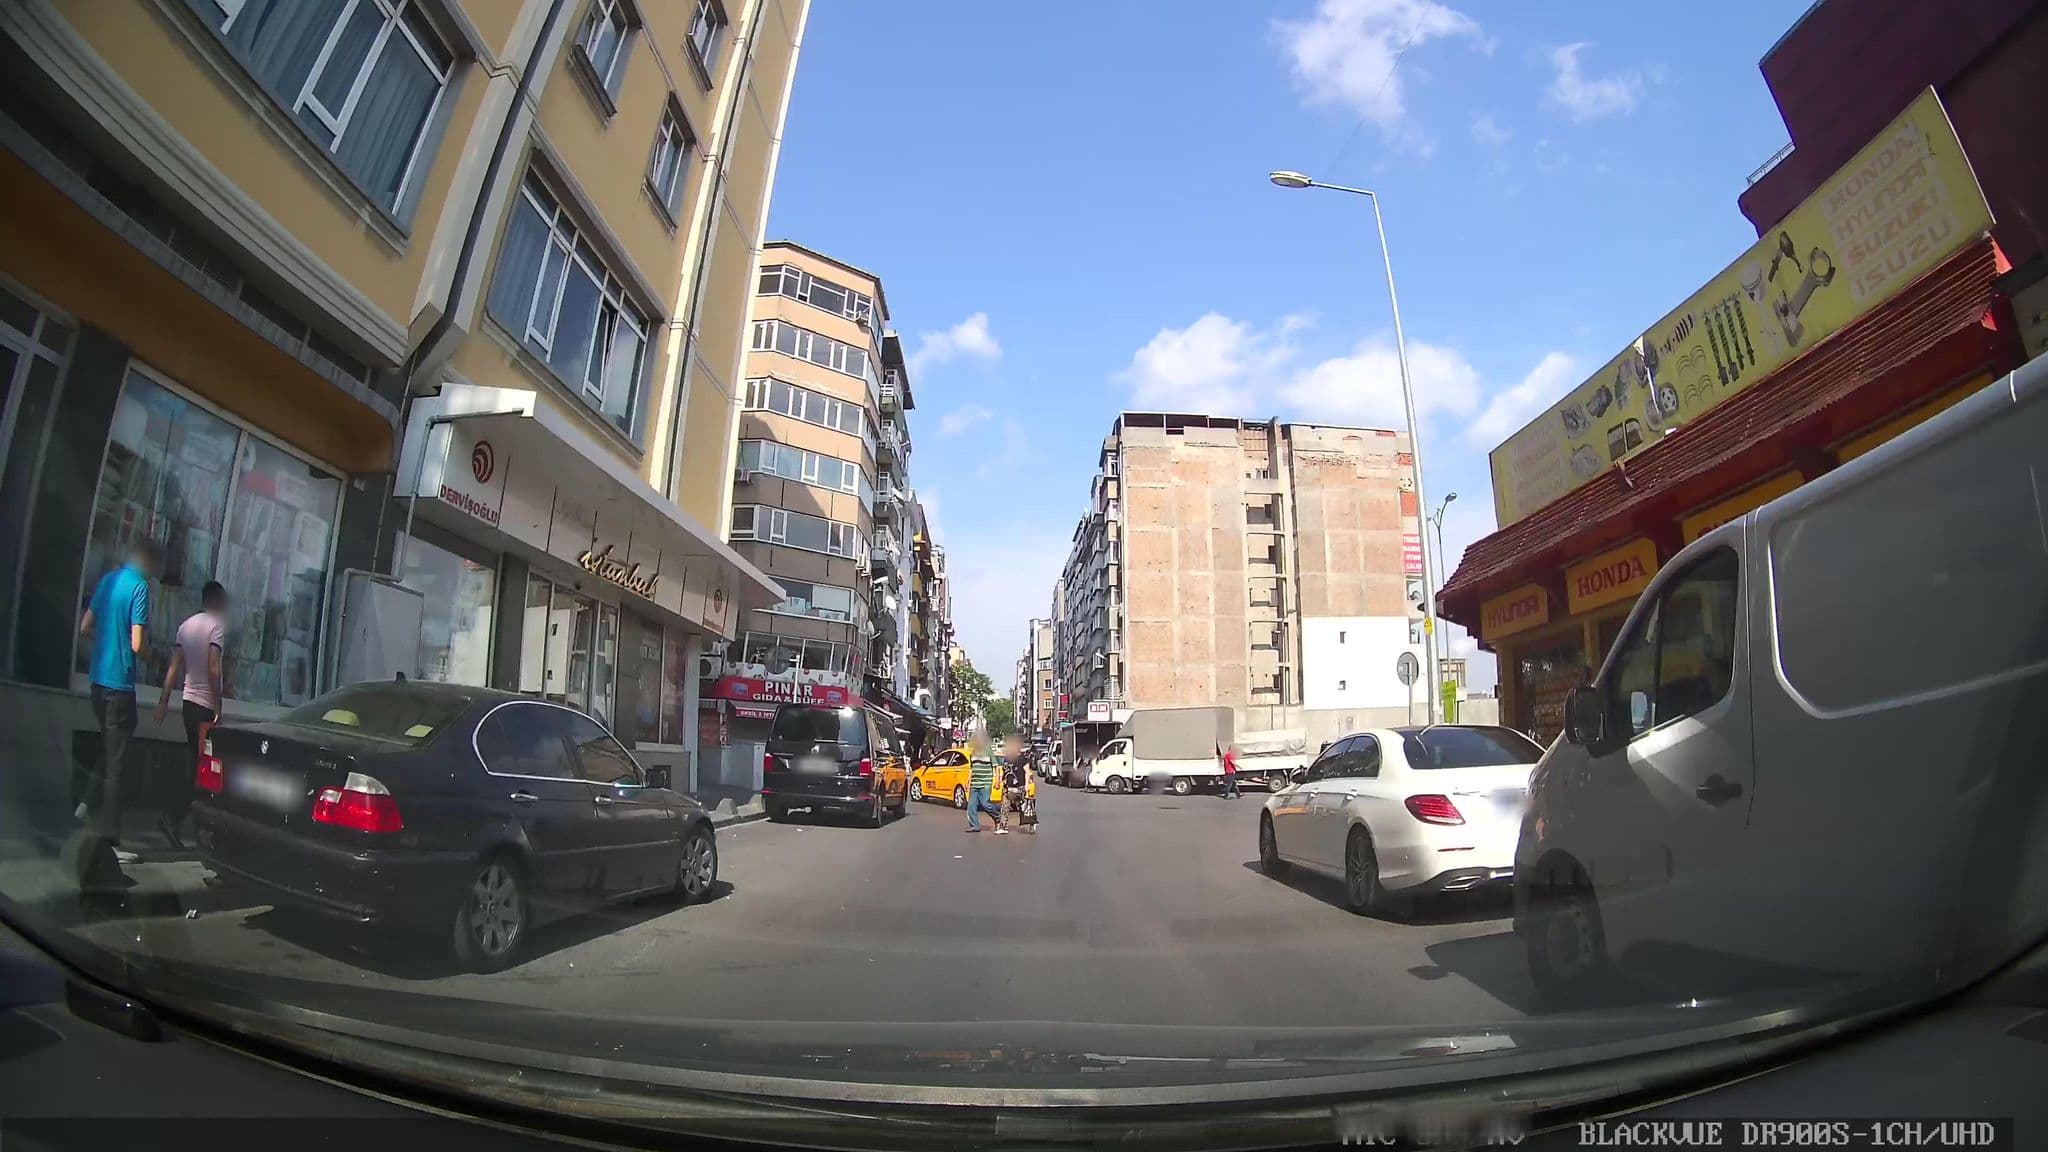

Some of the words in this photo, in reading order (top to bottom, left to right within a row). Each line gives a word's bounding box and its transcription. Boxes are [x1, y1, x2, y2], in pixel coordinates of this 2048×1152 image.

[1856, 215, 1950, 296] ISUZU
[1576, 554, 1648, 598] HONDA
[1487, 594, 1540, 629] HYUNDAI
[765, 681, 813, 697] PINAR
